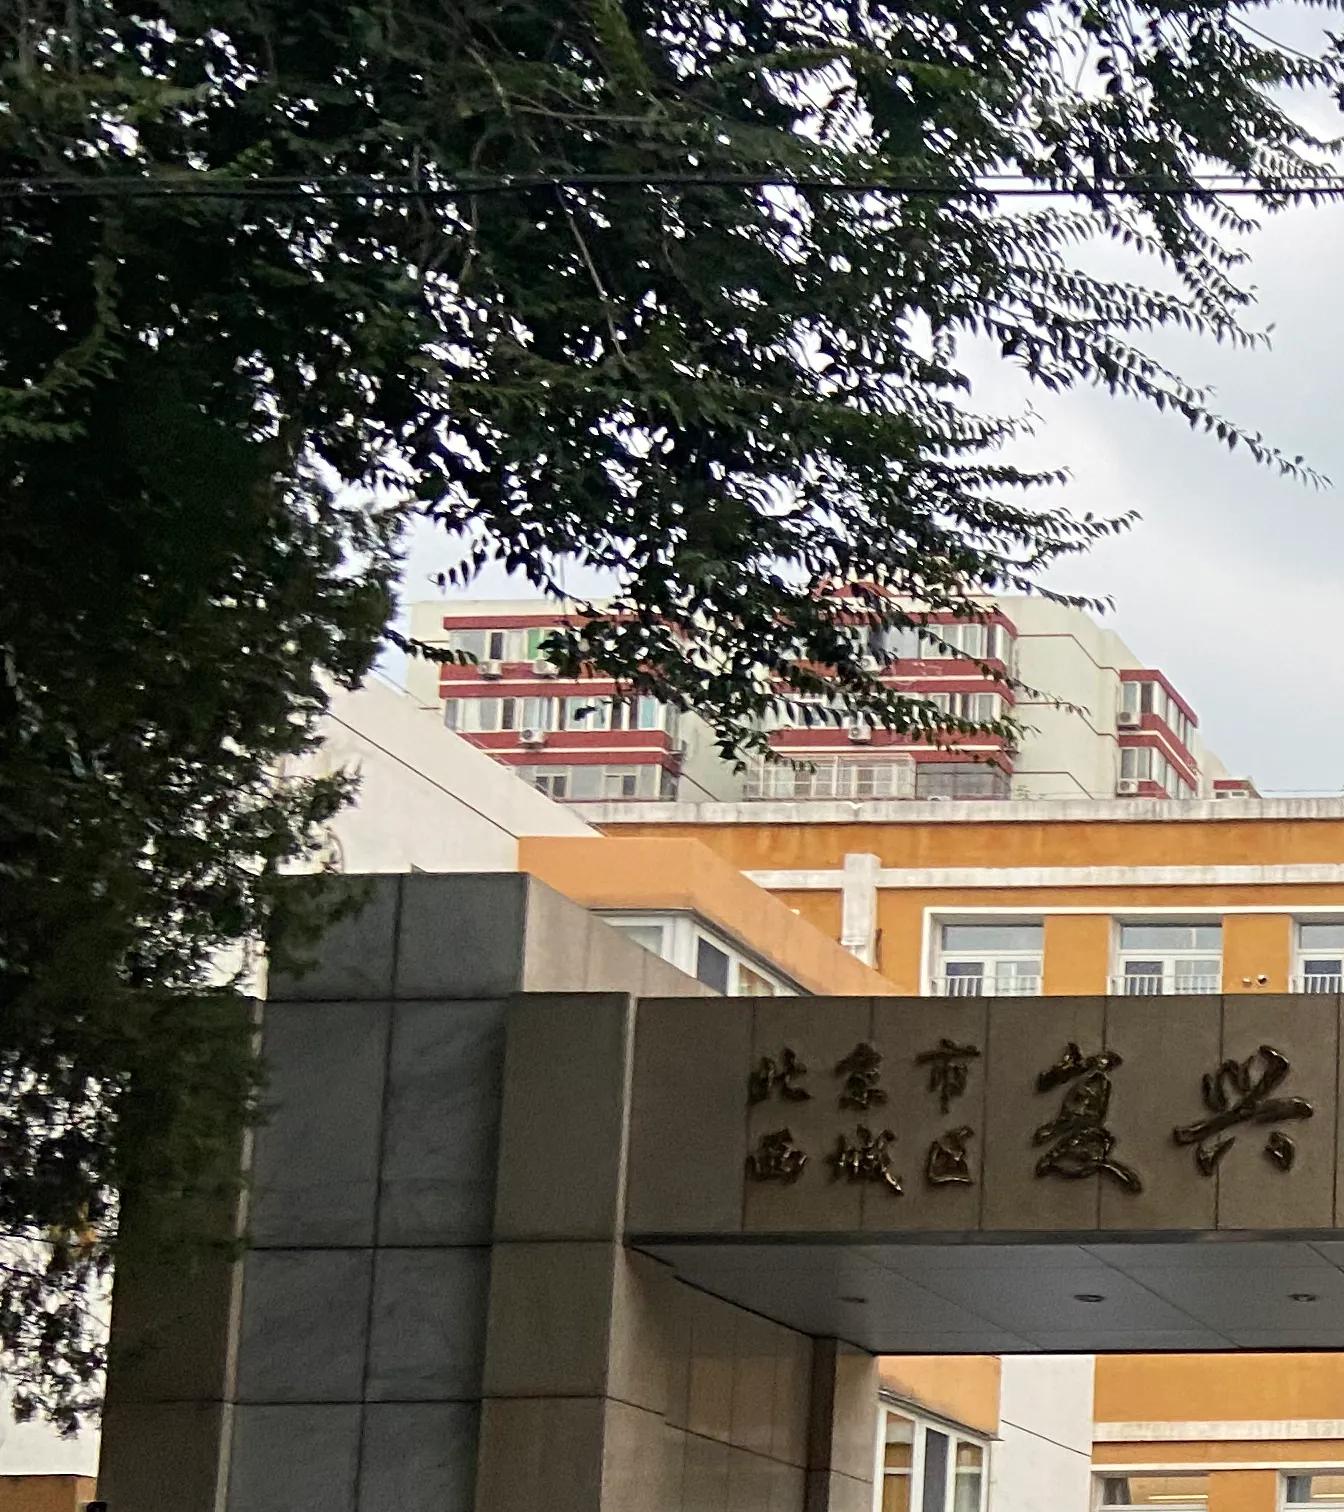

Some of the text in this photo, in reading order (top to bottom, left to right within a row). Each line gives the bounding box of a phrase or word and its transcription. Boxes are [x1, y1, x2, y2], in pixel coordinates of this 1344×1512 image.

[746, 1038, 982, 1114] 北京市
[744, 1124, 976, 1195] 西城区
